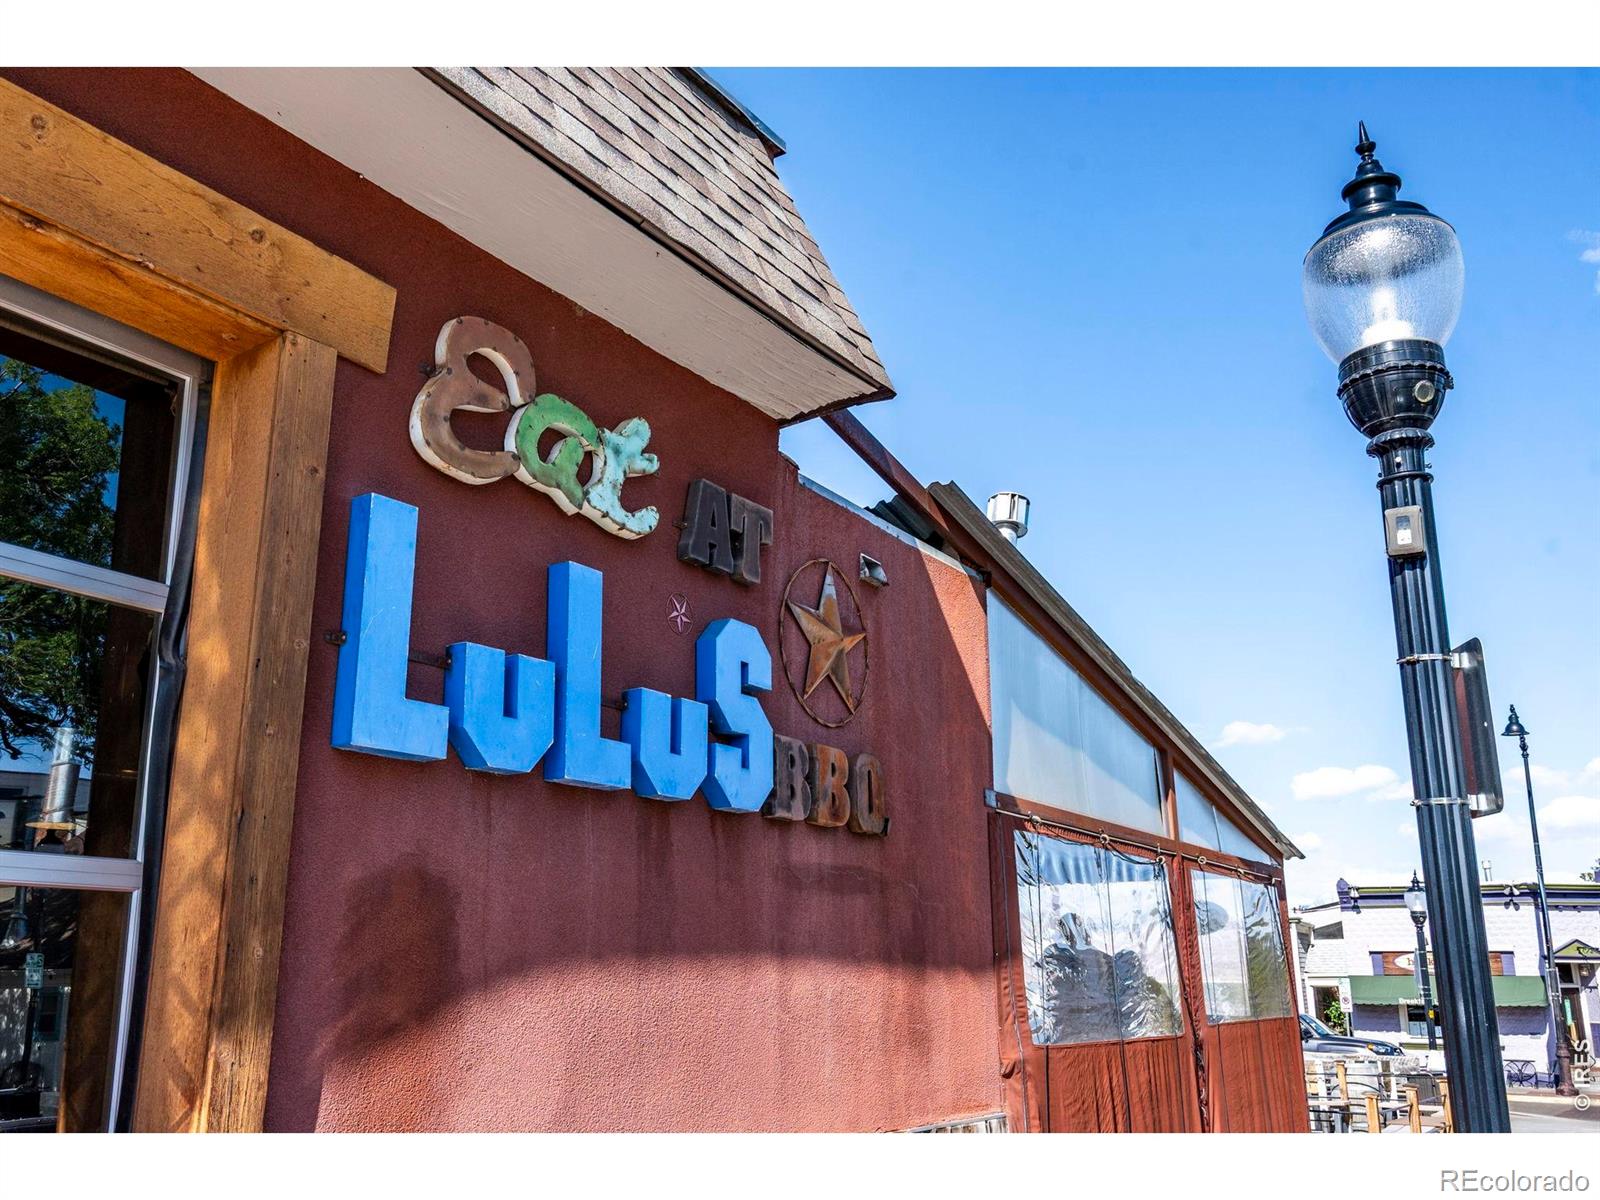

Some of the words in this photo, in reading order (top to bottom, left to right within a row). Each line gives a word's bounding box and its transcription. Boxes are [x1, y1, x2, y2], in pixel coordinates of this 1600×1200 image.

[409, 315, 660, 540] Eat
[677, 478, 774, 585] AT
[761, 734, 892, 837] BBQ
